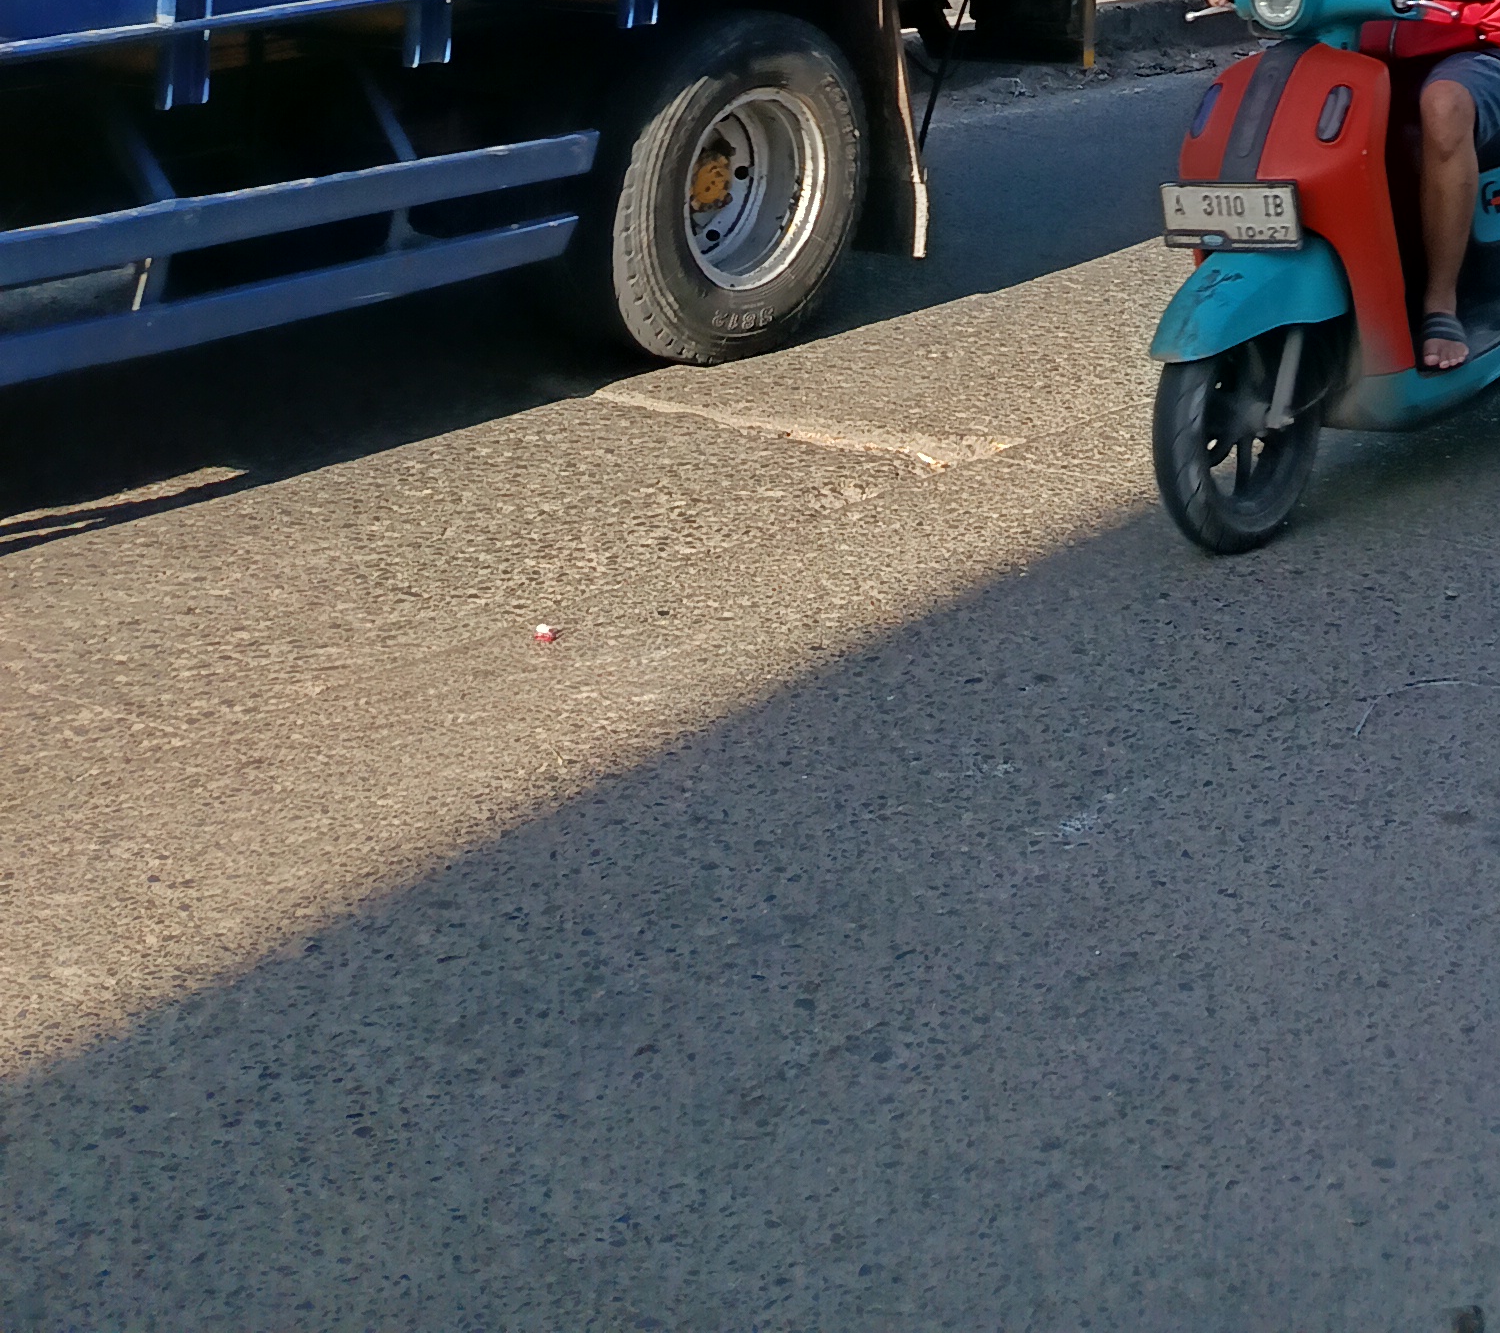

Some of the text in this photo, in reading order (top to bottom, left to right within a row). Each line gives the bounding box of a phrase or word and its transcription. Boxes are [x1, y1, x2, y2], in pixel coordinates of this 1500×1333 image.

[1174, 194, 1285, 218] A 3110 IB
